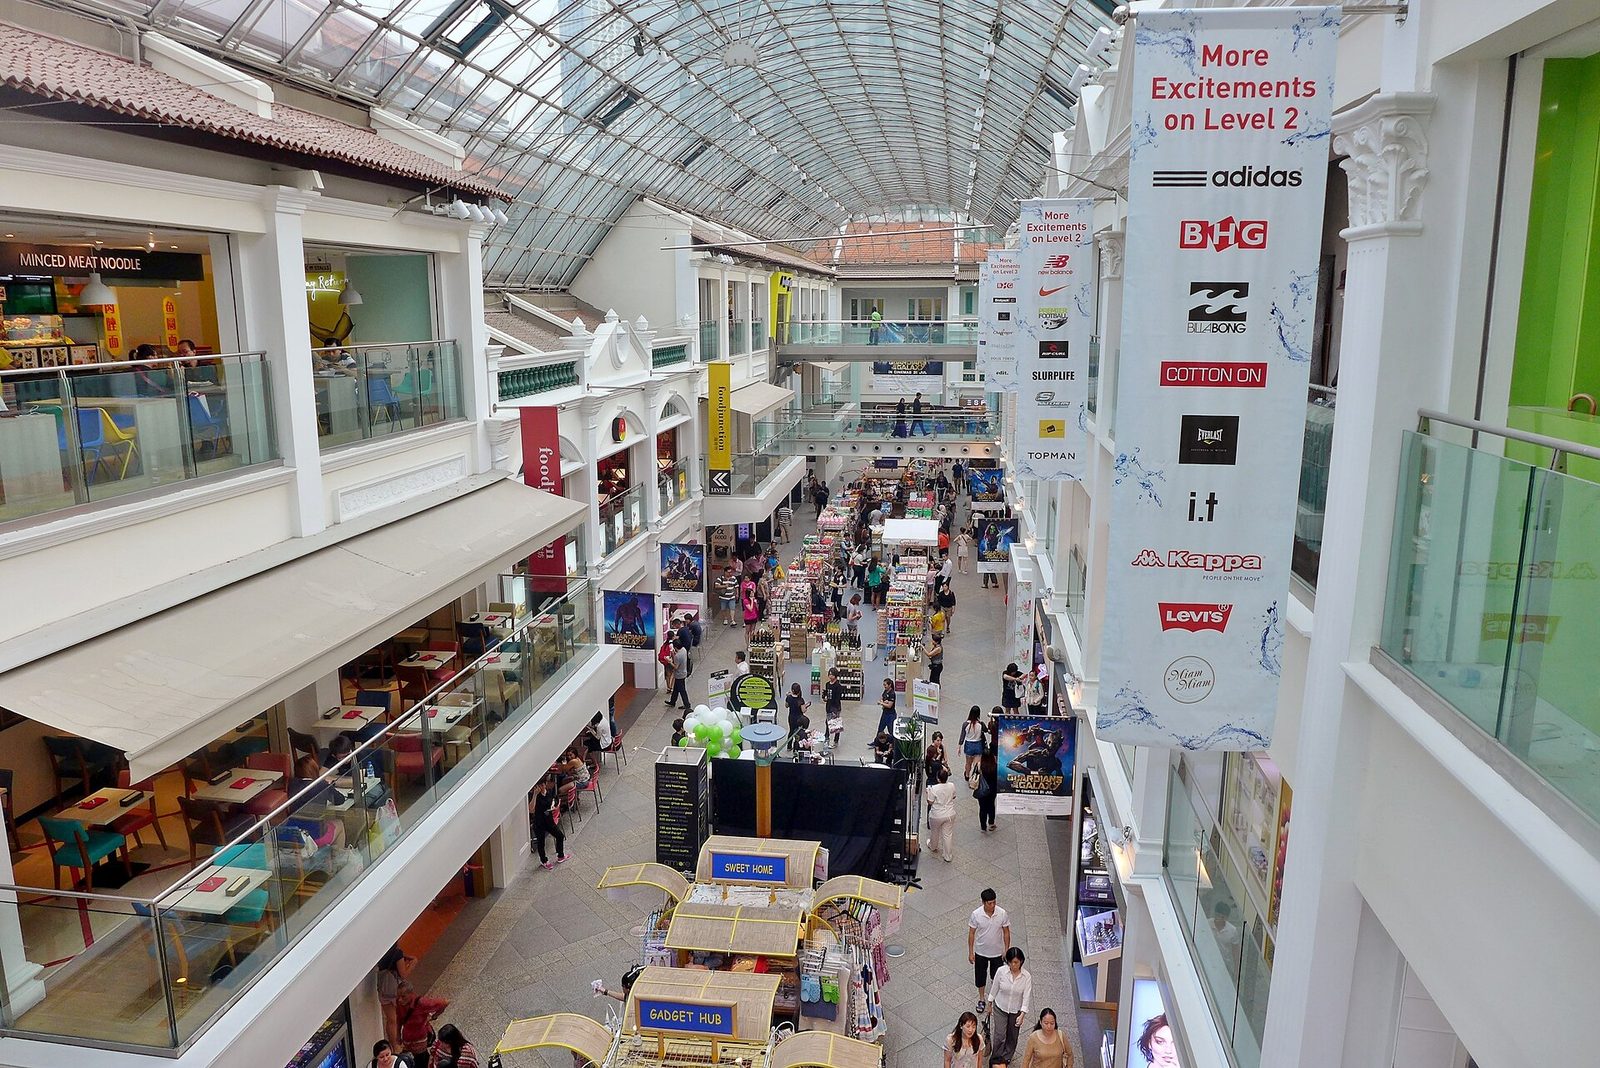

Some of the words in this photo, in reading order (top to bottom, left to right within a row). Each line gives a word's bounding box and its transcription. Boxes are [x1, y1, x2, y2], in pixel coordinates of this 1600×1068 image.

[1202, 44, 1269, 67] More
[1151, 76, 1316, 100] Excitements
[1164, 112, 1195, 131] on
[1204, 107, 1275, 130] Level
[1283, 107, 1299, 130] 2
[1211, 165, 1302, 187] adidas
[1044, 211, 1069, 220] More
[1026, 222, 1087, 232] Excitements
[1183, 222, 1265, 246] BHG
[1032, 235, 1044, 243] on
[1046, 233, 1072, 243] Level
[1075, 233, 1081, 242] 2
[19, 253, 66, 268] MINCED
[68, 255, 98, 269] MEAT
[100, 257, 142, 271] NOODLE
[1166, 366, 1232, 382] COTTON
[1237, 367, 1262, 383] ON
[717, 386, 727, 451] foodjunction
[1197, 428, 1223, 441] EVERLAST
[1027, 452, 1076, 460] TOPMAN
[1188, 491, 1219, 522] i.t
[1168, 551, 1262, 572] Kappa
[1167, 668, 1203, 681] Miam
[1176, 678, 1211, 691] Miam
[1007, 774, 1063, 783] GUARDIANS
[724, 863, 750, 873] SWEET
[752, 864, 773, 875] HOME
[649, 1008, 694, 1023] GADGET
[699, 1012, 722, 1025] HUB
